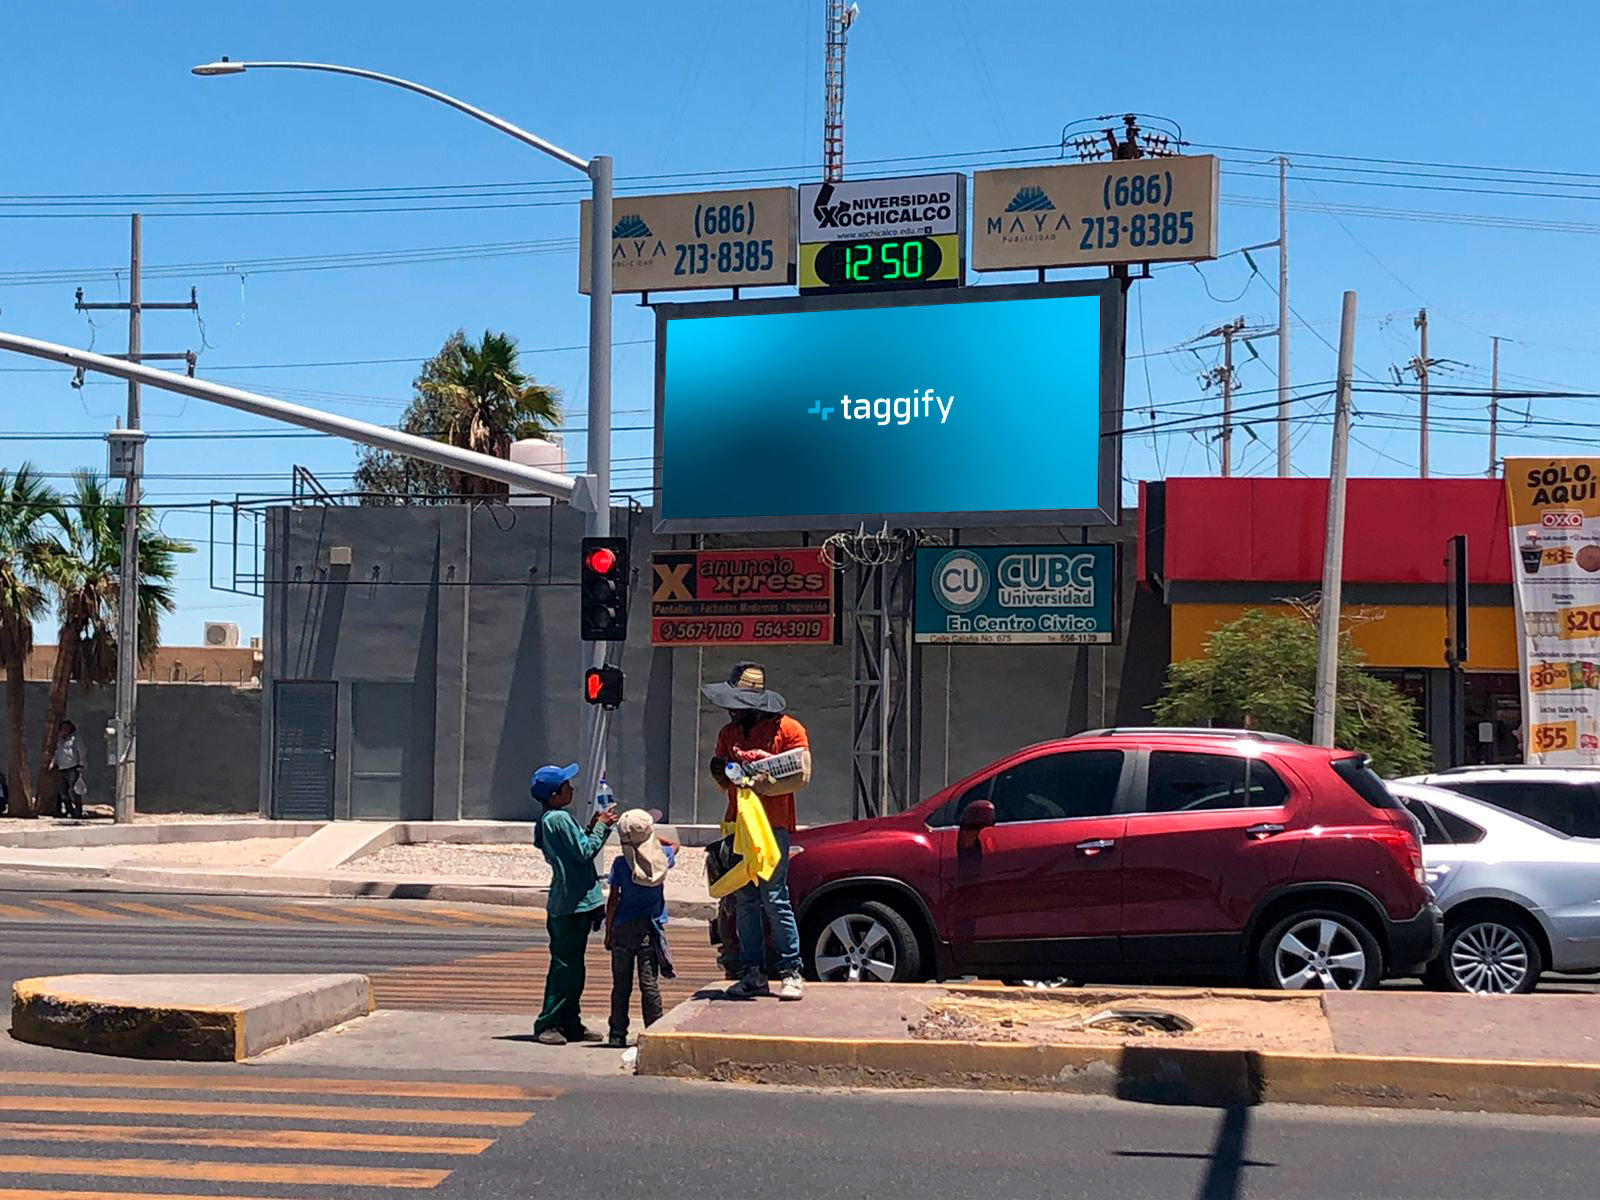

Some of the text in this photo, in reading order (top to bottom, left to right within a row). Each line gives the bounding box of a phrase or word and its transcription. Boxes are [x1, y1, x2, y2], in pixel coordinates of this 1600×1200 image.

[1103, 170, 1173, 211] (686)
[694, 201, 755, 238] (686)
[818, 205, 951, 229] XOCHICALCO
[987, 213, 1071, 234] MAYA
[612, 240, 667, 259] AYA
[840, 388, 955, 426] taggify
[1527, 462, 1591, 488] SÓLO
[1531, 476, 1597, 506] AQUÍ
[701, 555, 794, 577] anuncio
[998, 555, 1095, 589] CUBC
[715, 572, 824, 596] xpress
[942, 568, 978, 592] CU
[1000, 590, 1092, 606] Universidad
[677, 622, 821, 639] 567-7180 564-3919
[947, 613, 1097, 631] En Centro Cívico
[1535, 727, 1568, 749] $55
